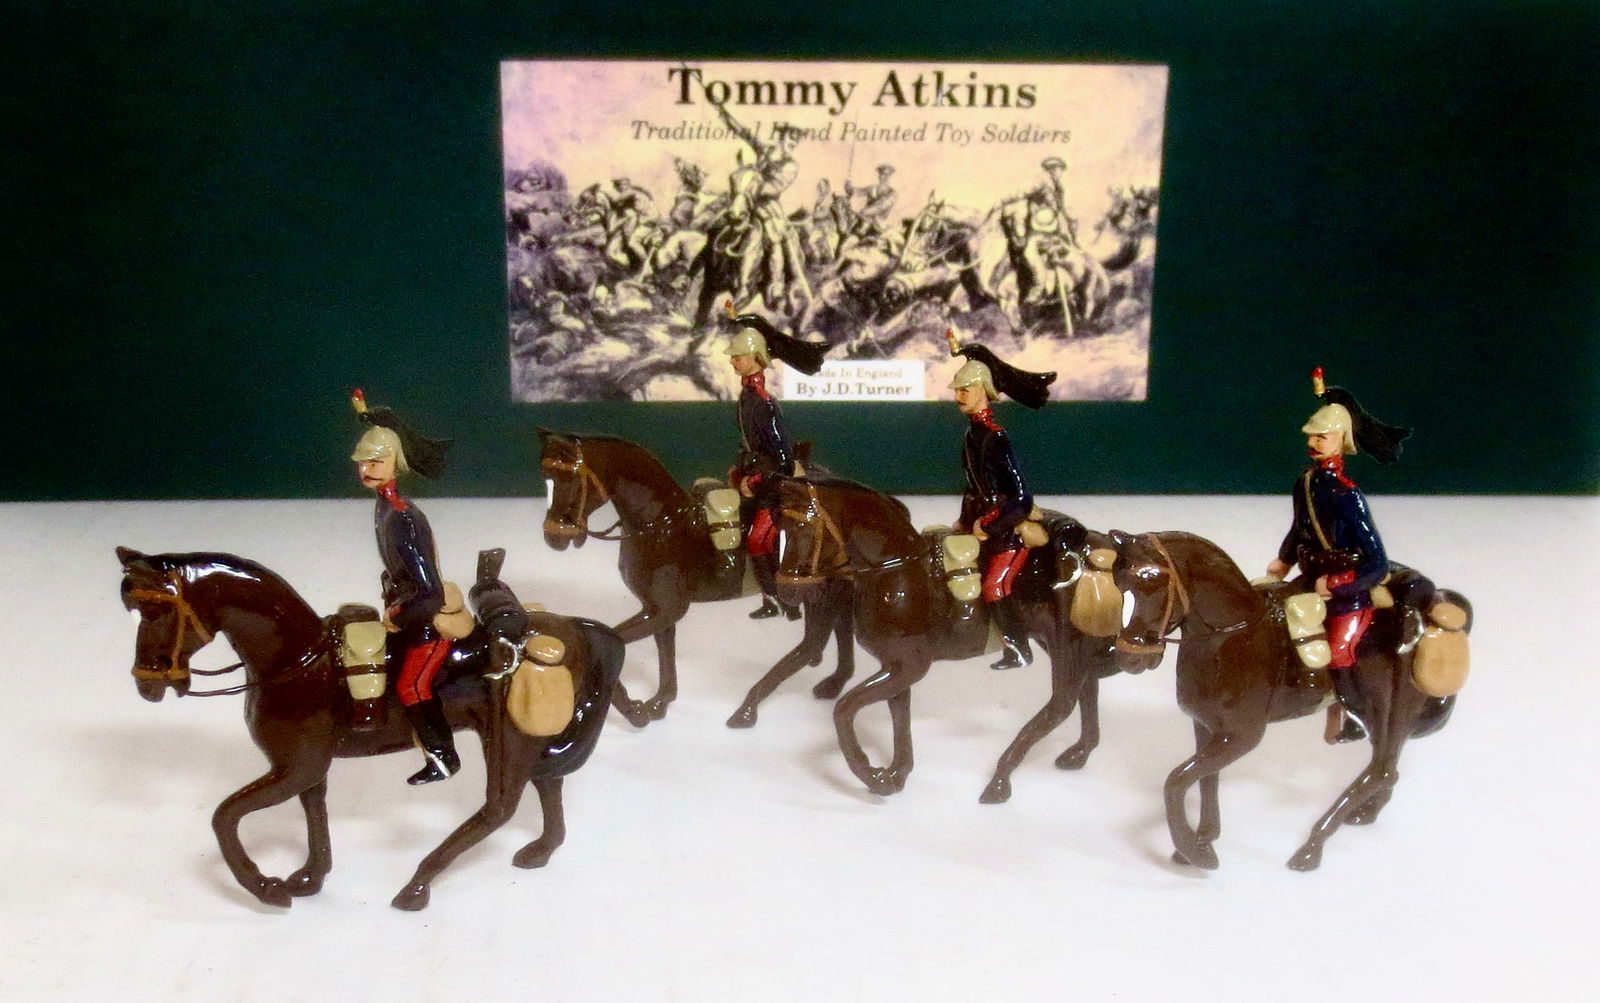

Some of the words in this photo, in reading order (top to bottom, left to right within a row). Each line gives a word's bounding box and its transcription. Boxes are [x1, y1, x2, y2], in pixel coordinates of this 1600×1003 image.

[668, 68, 858, 115] Tommy
[871, 69, 1037, 108] Atkins
[840, 122, 927, 143] Painted
[934, 123, 974, 146] Toy
[981, 123, 1071, 144] Soldiers
[856, 368, 903, 380] England
[796, 382, 817, 397] By
